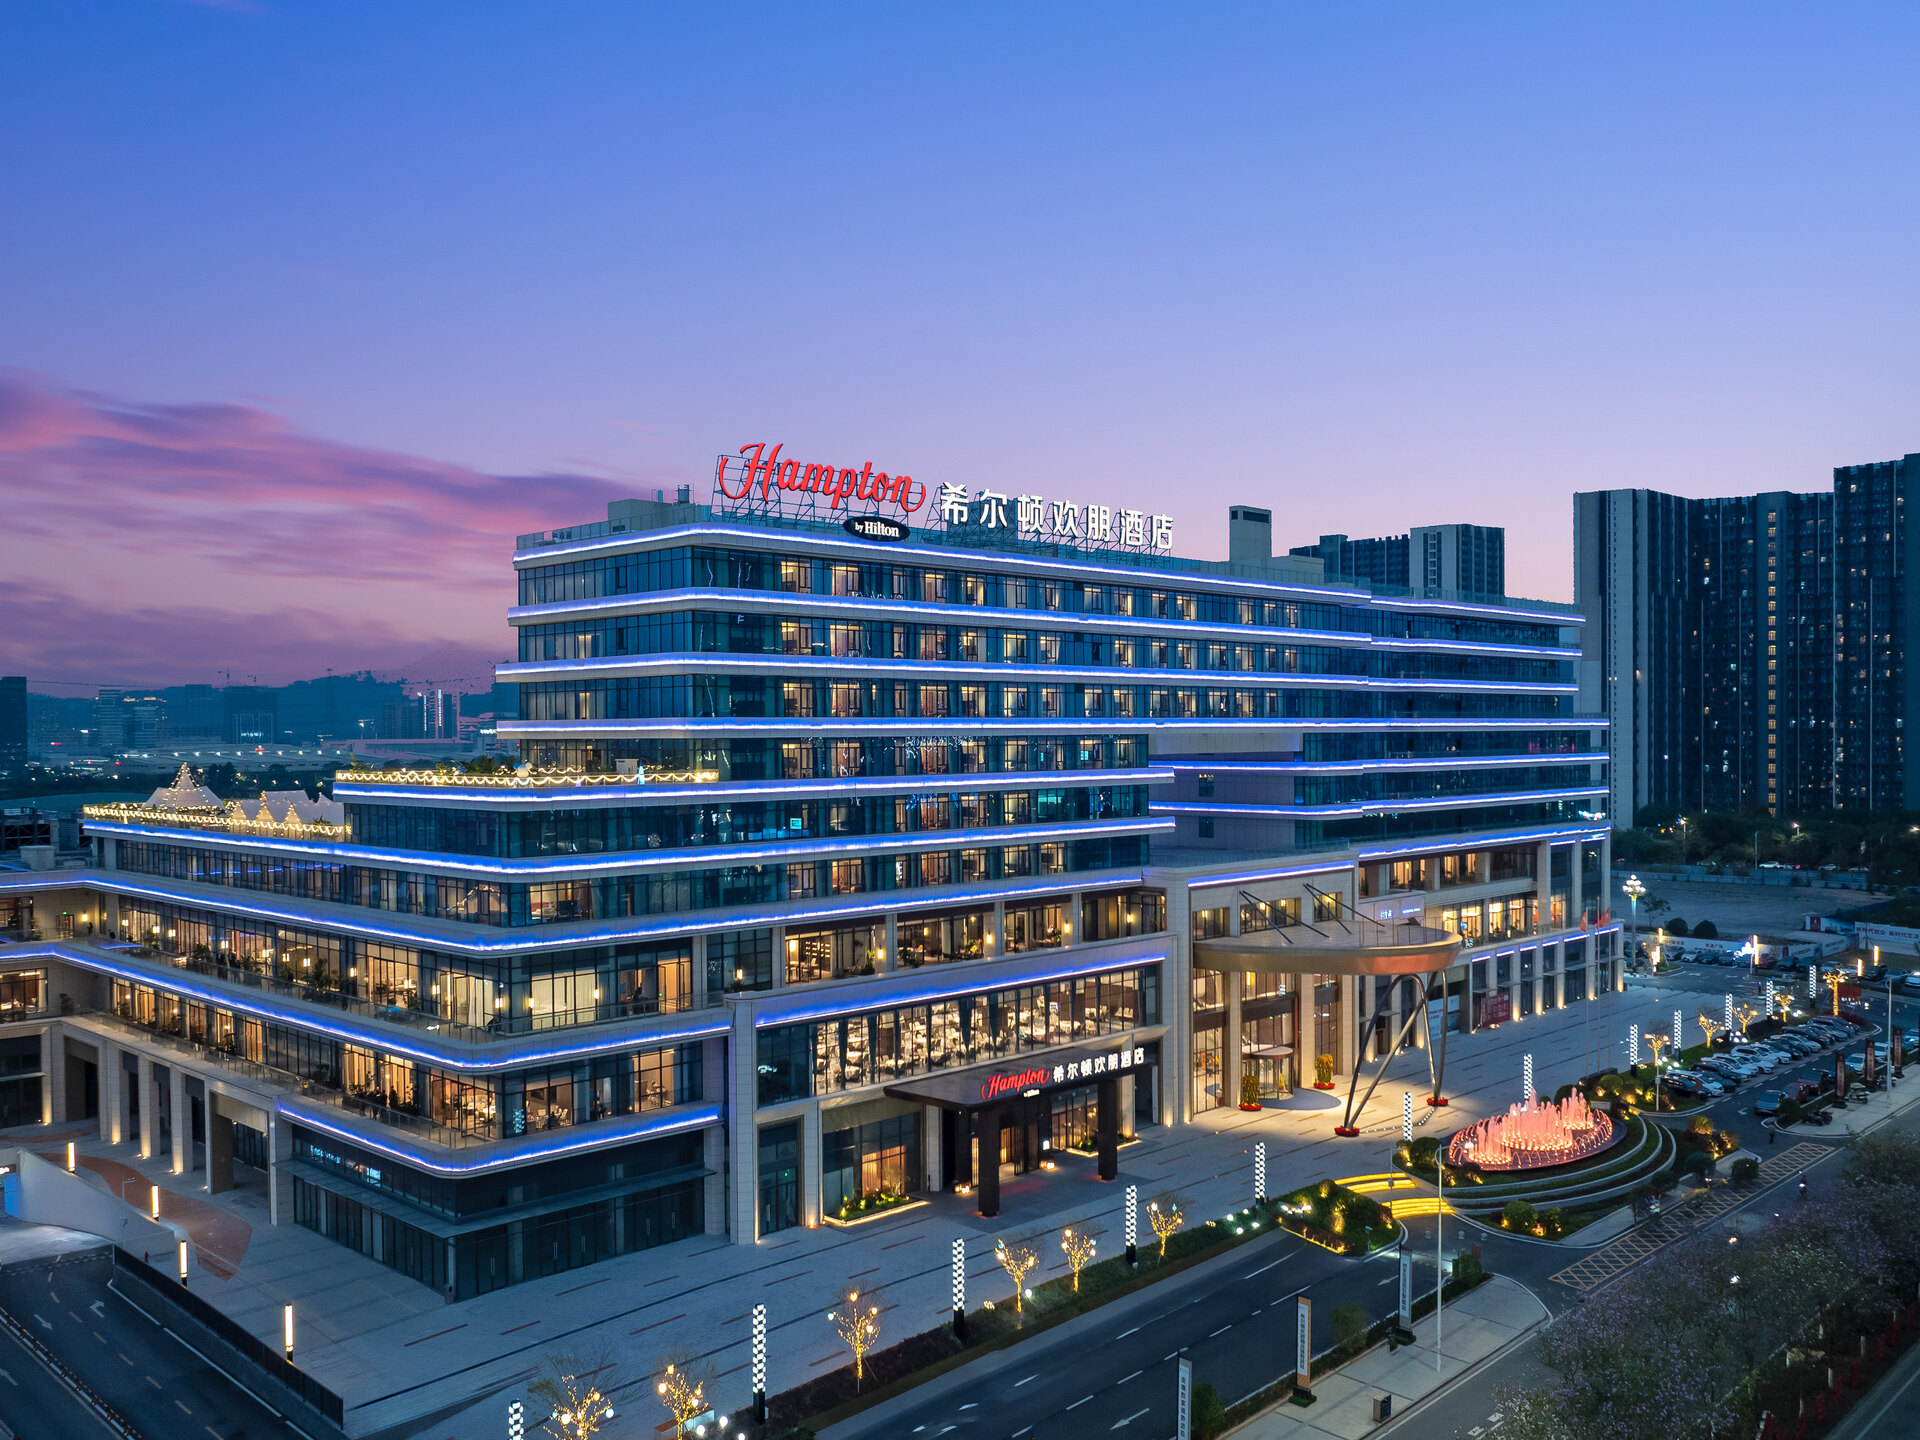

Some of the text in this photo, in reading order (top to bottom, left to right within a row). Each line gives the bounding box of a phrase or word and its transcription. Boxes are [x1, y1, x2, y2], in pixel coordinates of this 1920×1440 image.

[718, 443, 927, 512] Hampton
[854, 520, 900, 538] by Hilton
[939, 481, 1174, 550] 希尔顿欢朋酒店
[1052, 1047, 1145, 1083] 希尔顿欢朋酒店
[980, 1068, 1050, 1100] Hampton
